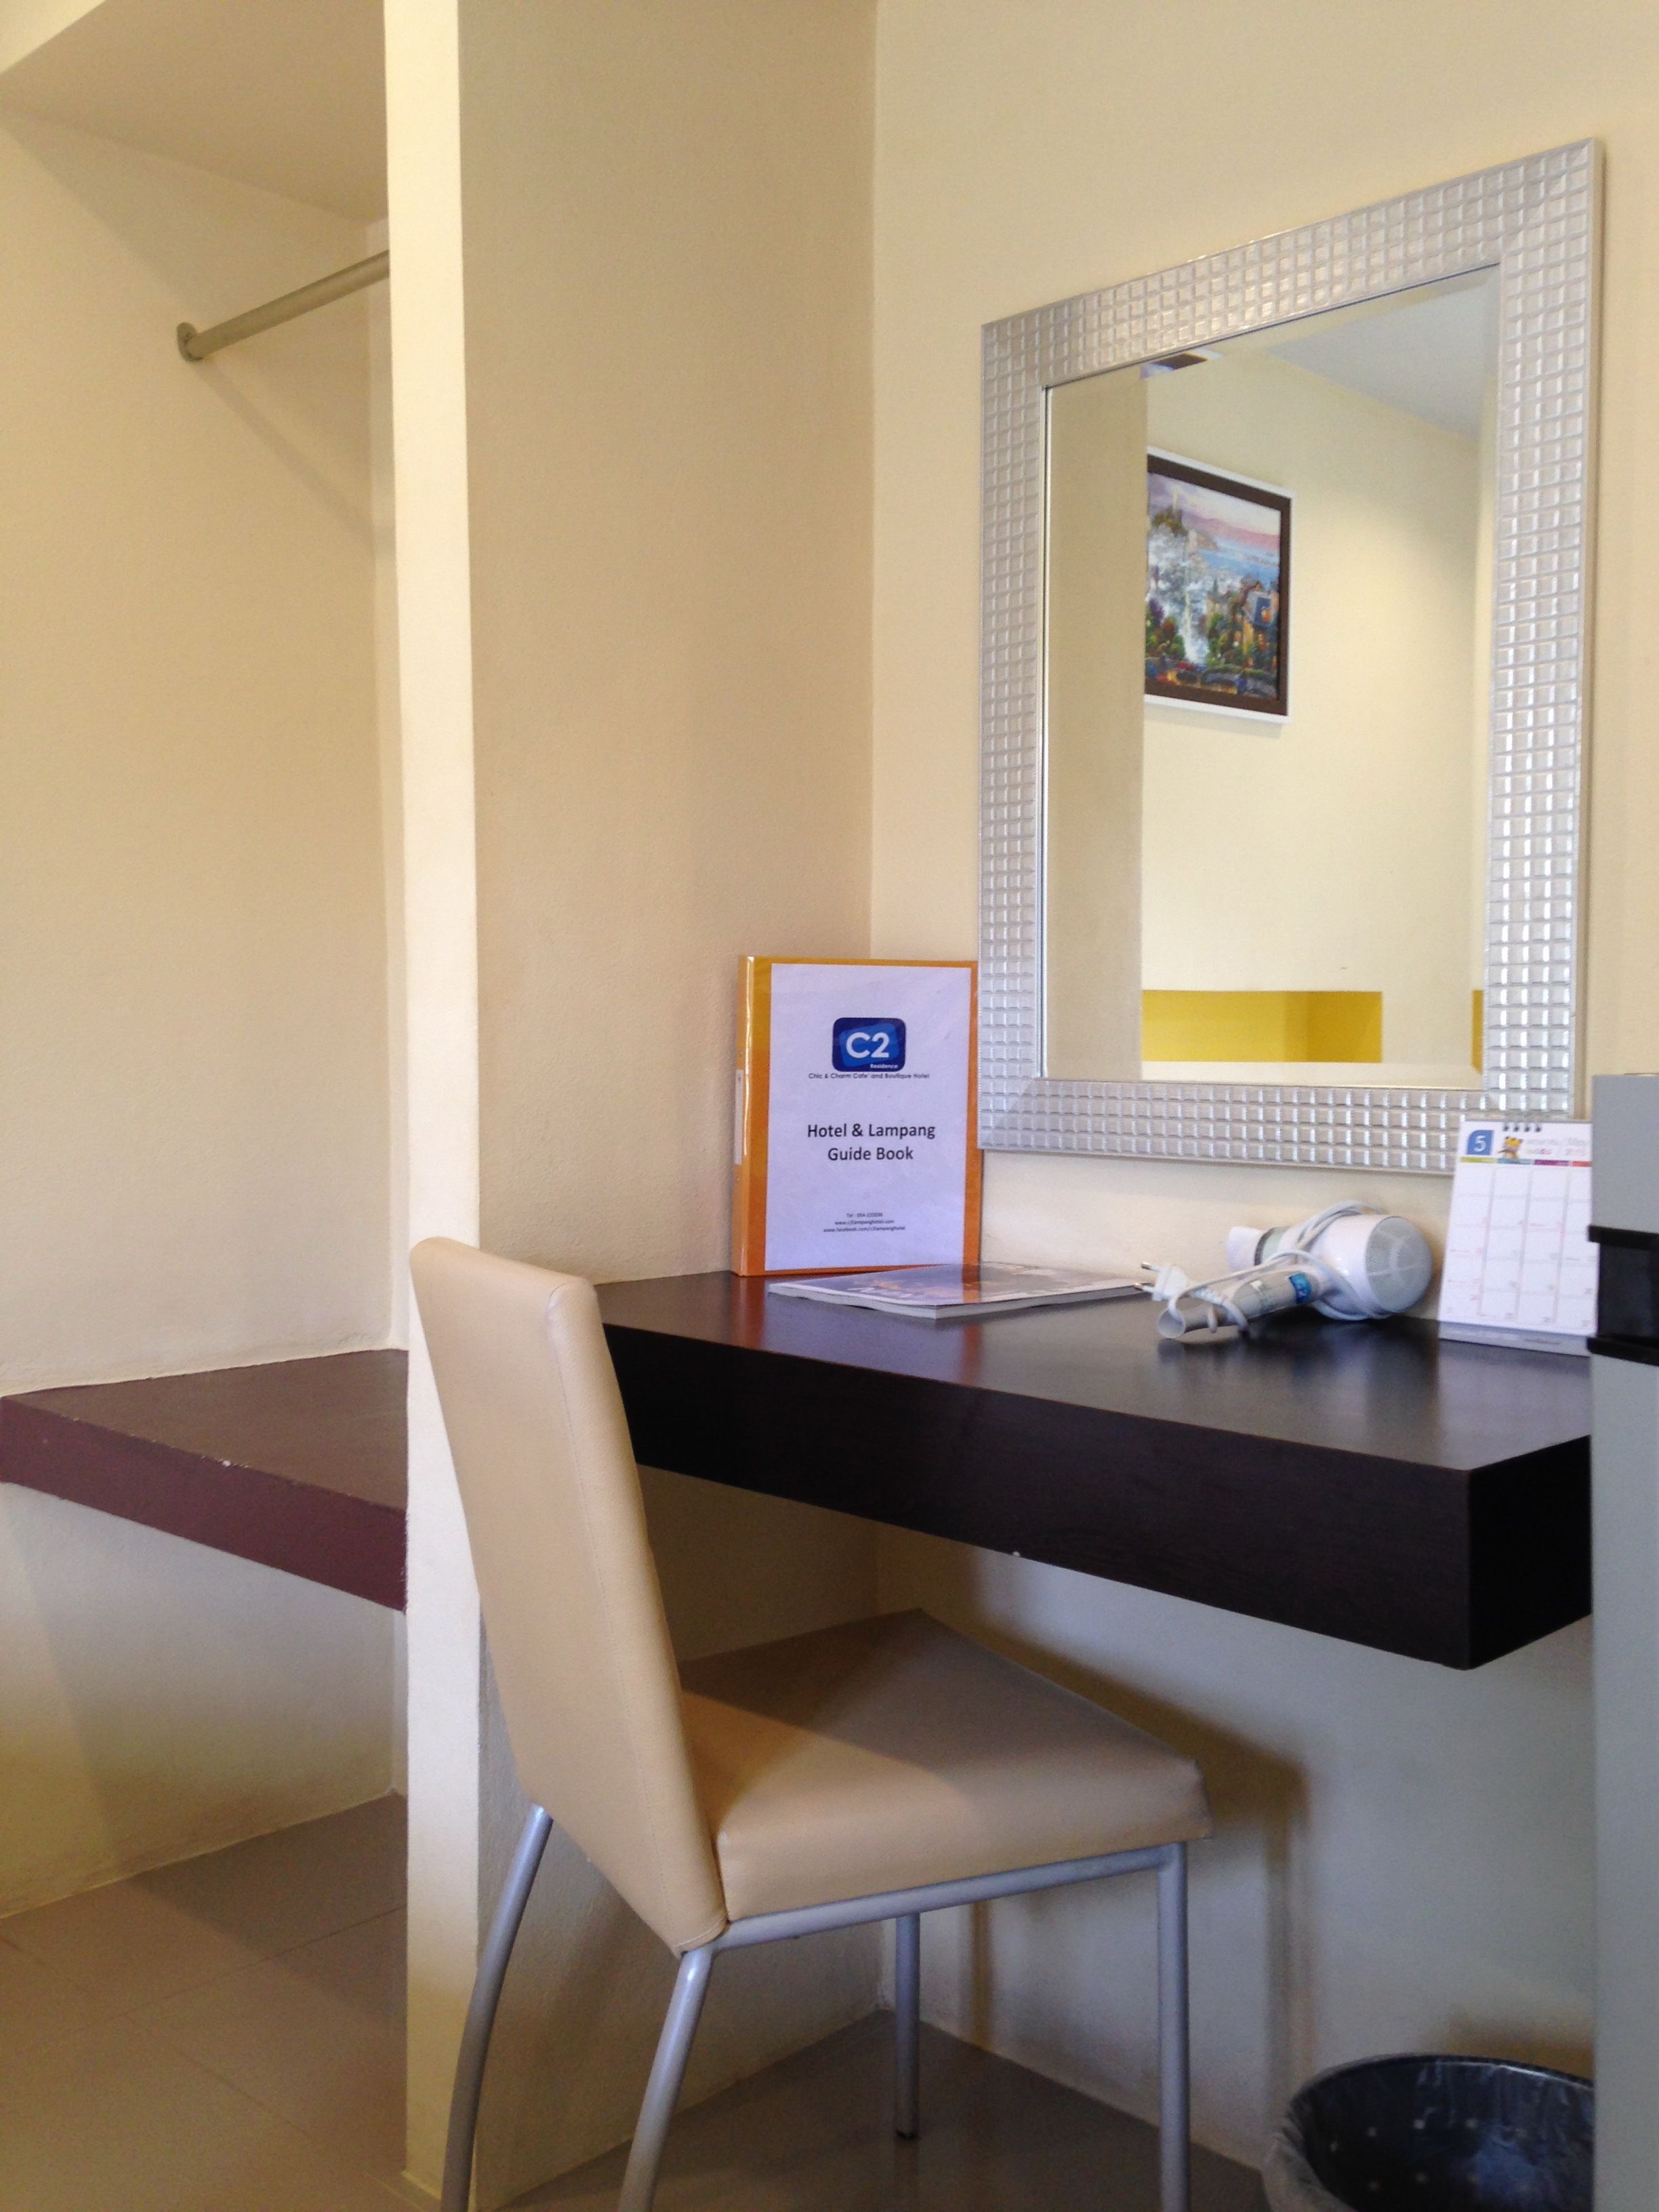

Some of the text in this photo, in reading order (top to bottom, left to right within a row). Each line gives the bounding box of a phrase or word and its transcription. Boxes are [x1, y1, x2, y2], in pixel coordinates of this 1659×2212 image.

[845, 1031, 890, 1059] C2
[808, 1124, 936, 1140] Hotel & Lampang
[1474, 1134, 1487, 1153] 5
[827, 1146, 914, 1161] Guide Book
